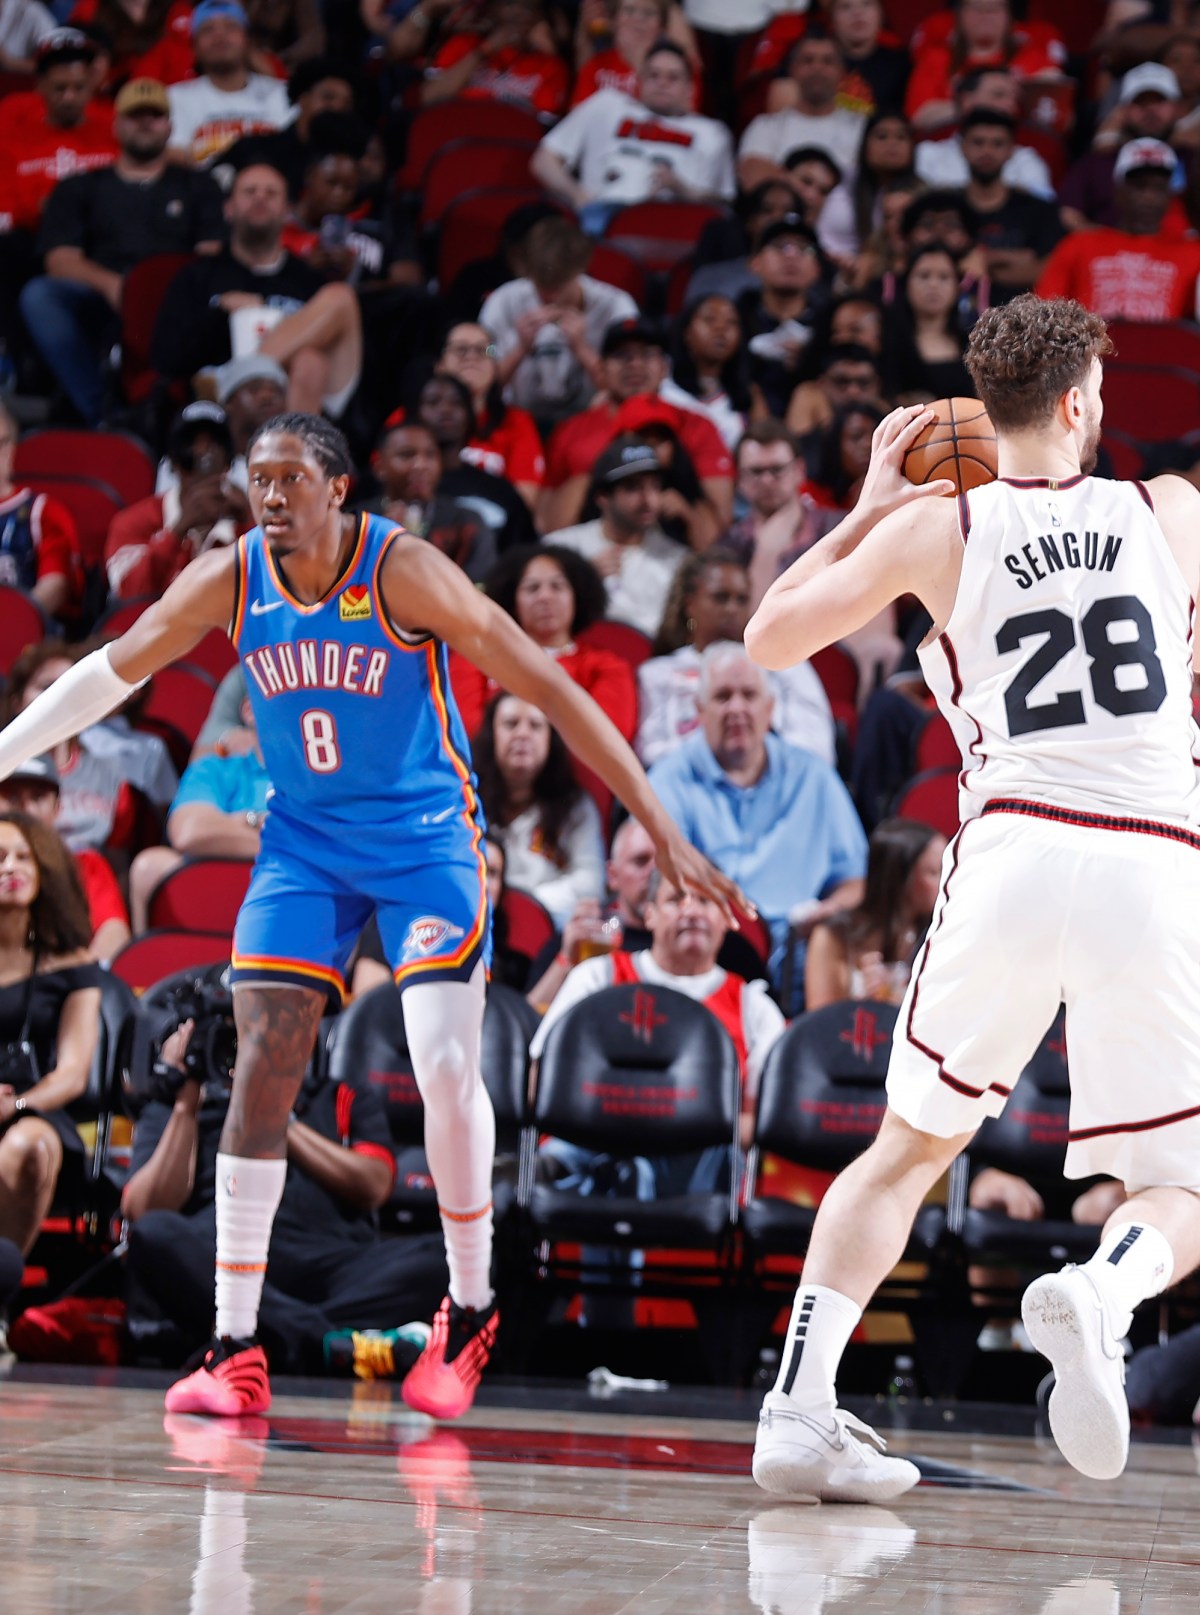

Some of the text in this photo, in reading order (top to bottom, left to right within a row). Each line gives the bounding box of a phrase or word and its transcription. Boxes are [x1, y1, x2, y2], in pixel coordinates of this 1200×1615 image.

[1004, 531, 1123, 590] SENGUN
[244, 639, 390, 699] THUNDER
[995, 595, 1168, 738] 28
[299, 707, 343, 775] 8
